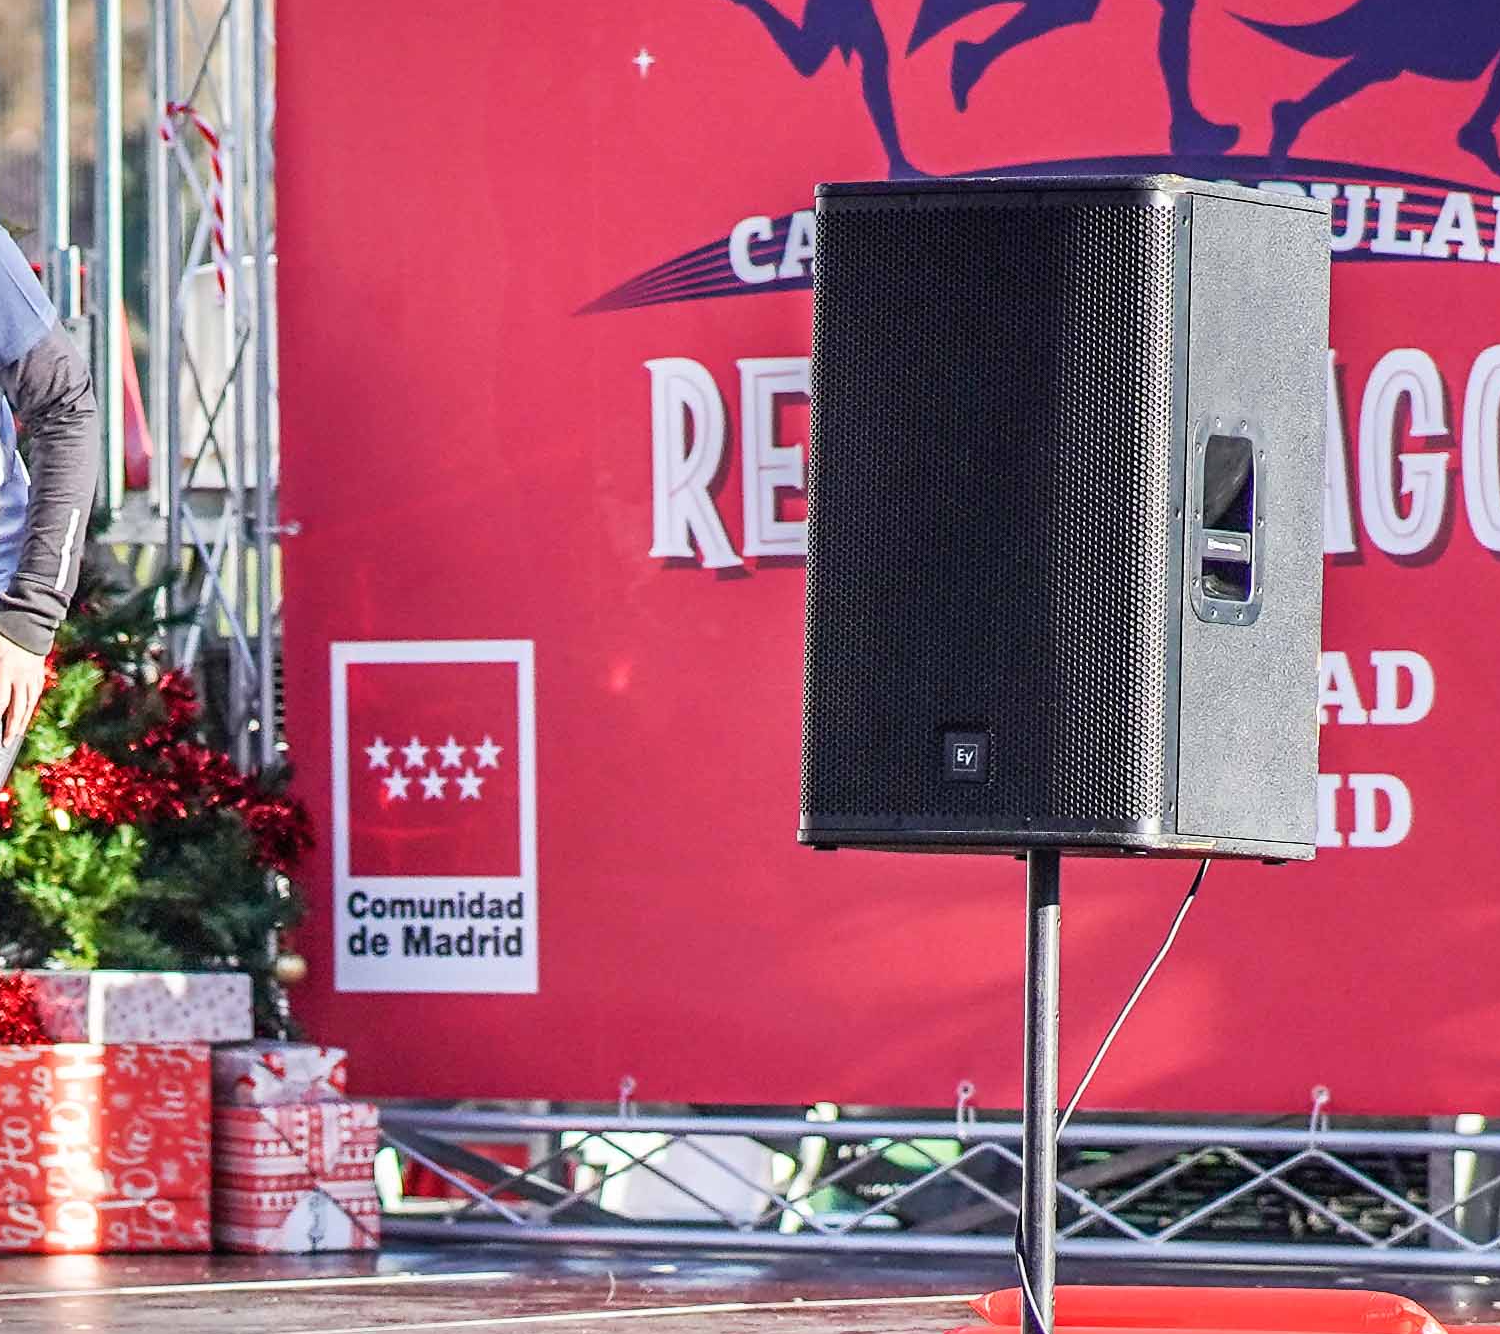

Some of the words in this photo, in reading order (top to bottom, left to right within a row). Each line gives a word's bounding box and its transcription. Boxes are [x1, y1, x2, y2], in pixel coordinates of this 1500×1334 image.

[347, 890, 524, 920] Comunidad
[348, 925, 390, 957] de
[401, 925, 524, 957] Madrid
